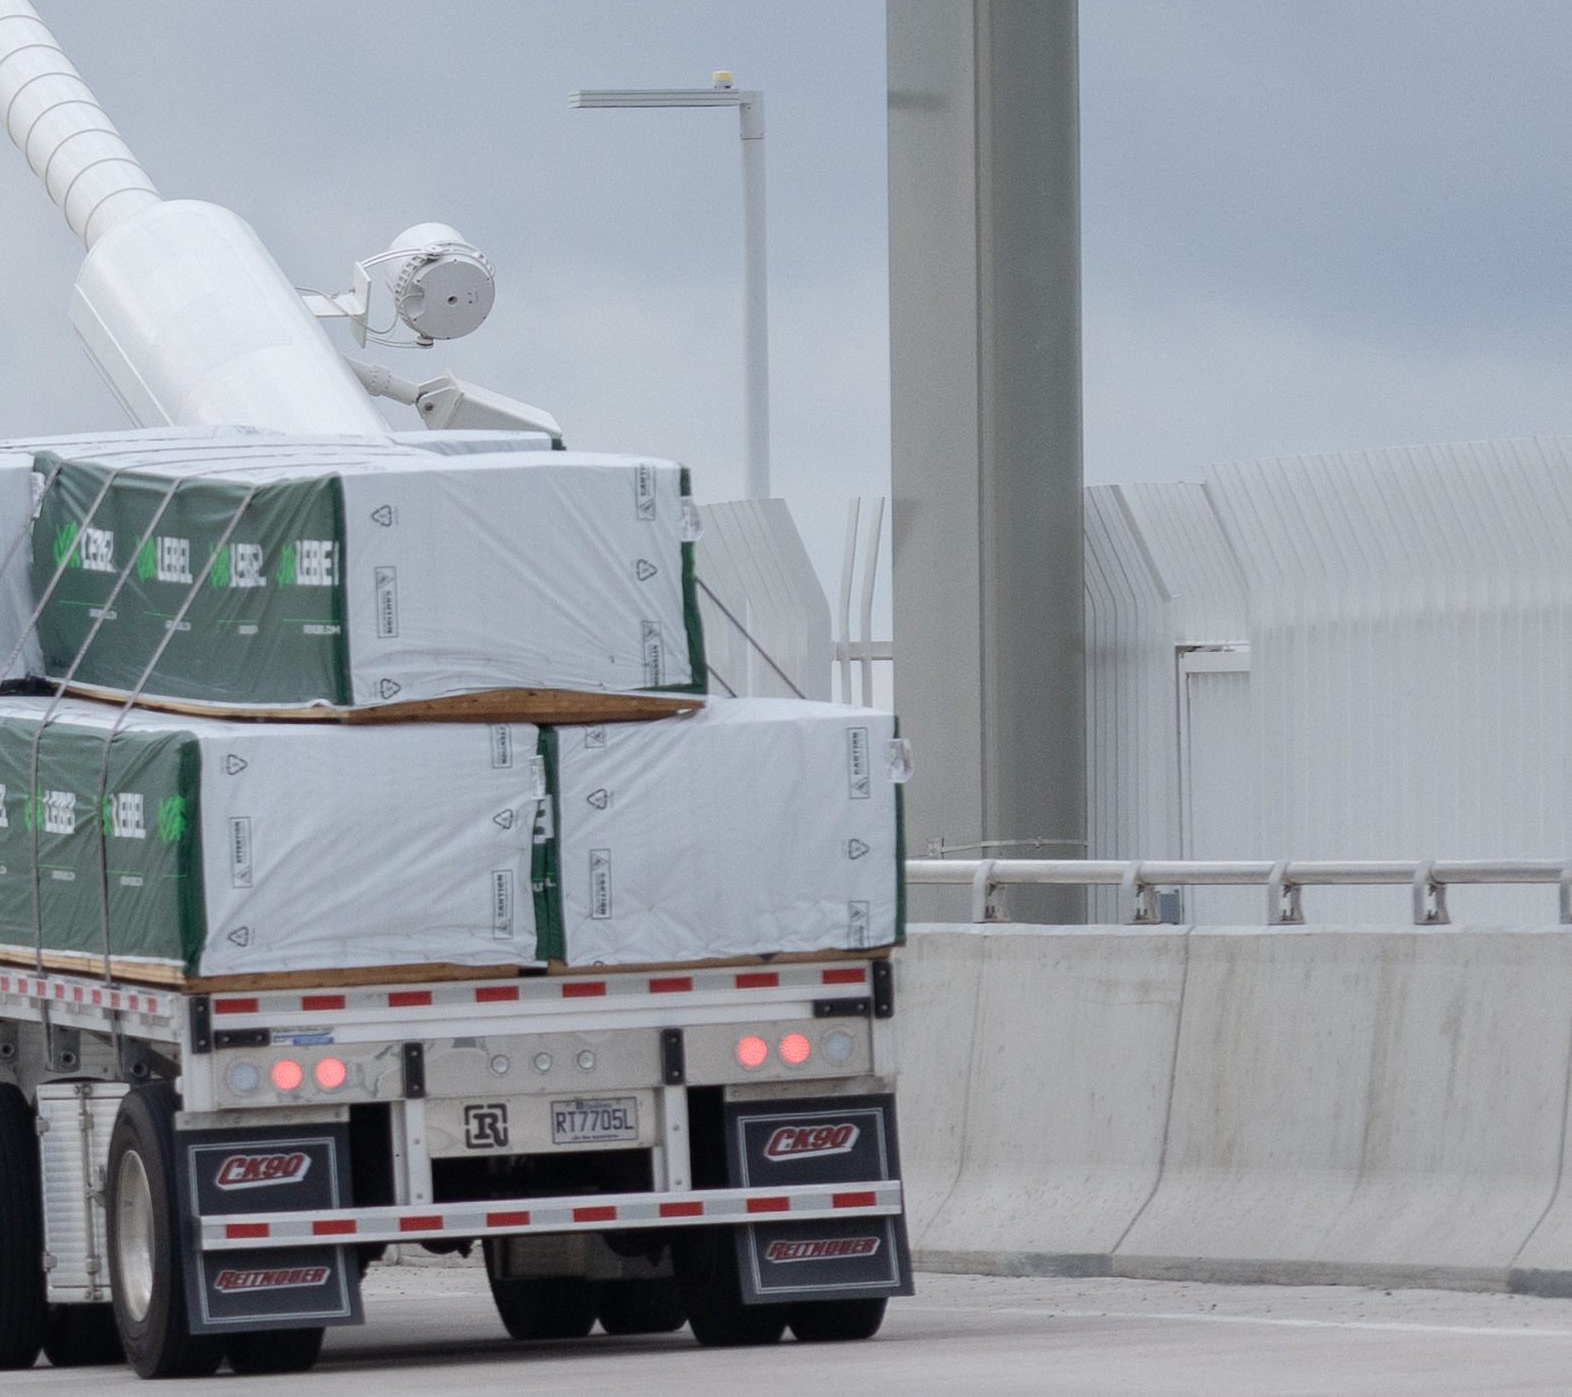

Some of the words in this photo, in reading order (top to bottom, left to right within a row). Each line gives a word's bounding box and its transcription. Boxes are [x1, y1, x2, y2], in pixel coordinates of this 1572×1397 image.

[555, 1108, 634, 1134] RT7705L
[764, 1123, 860, 1162] CK90
[215, 1152, 312, 1191] CK90
